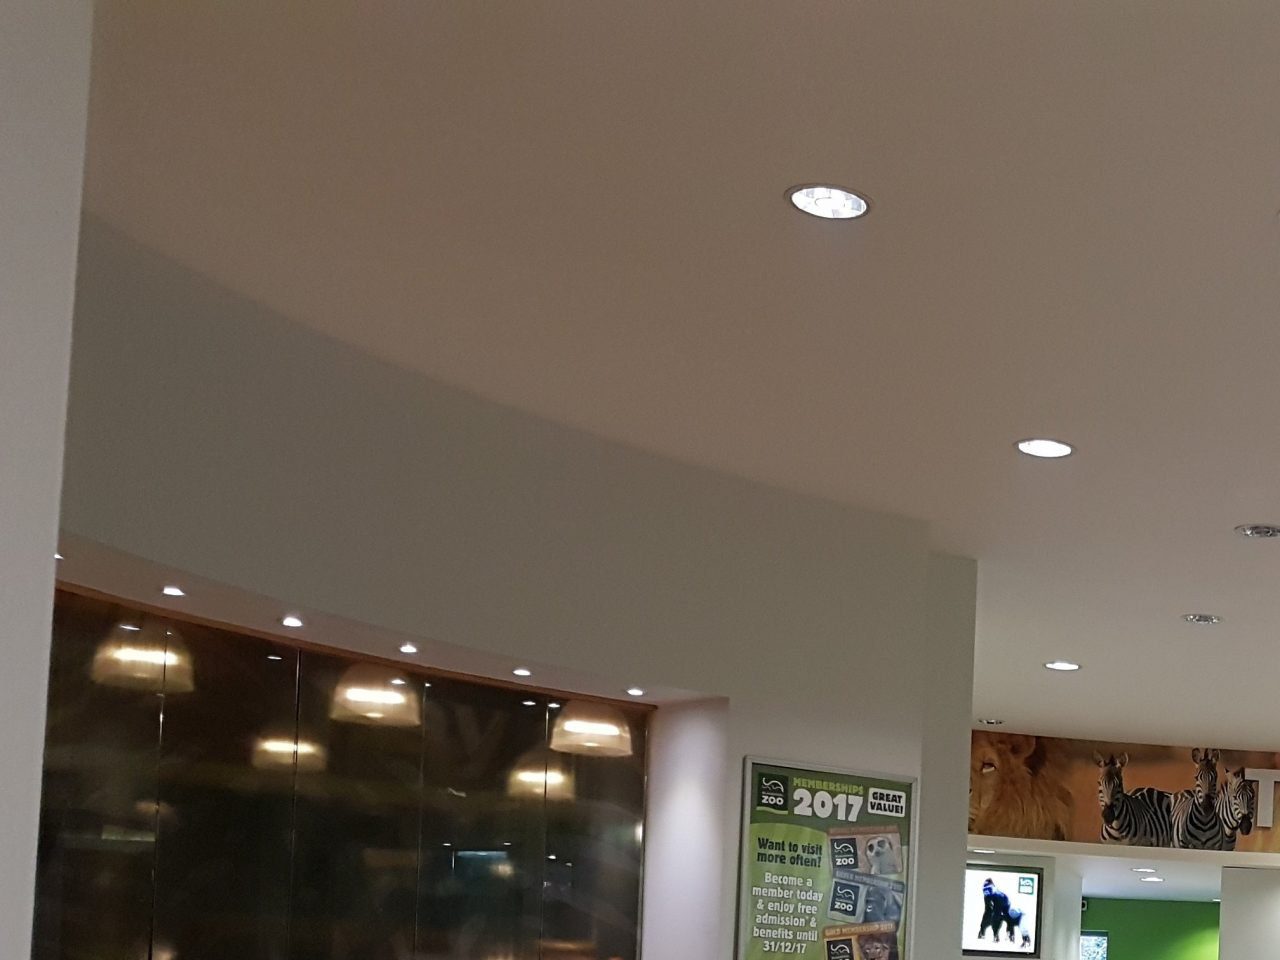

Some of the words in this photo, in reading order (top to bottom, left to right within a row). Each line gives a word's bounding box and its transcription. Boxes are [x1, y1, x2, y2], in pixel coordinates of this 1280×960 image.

[793, 777, 864, 795] MEMBERSHIPS
[761, 795, 784, 806] ZOO
[792, 788, 864, 822] 2017
[872, 791, 903, 804] GREAT
[870, 801, 904, 815] VALUE!
[757, 837, 785, 852] Want
[789, 841, 798, 853] to
[801, 843, 823, 856] visit
[757, 852, 786, 865] more
[789, 854, 822, 868] often?
[835, 857, 855, 866] ZOO
[764, 871, 803, 887] Become
[806, 877, 813, 887] a
[752, 886, 794, 898] member
[796, 888, 824, 902] today
[756, 899, 765, 910] &
[767, 900, 795, 914] enjoy
[797, 902, 818, 914] free
[834, 901, 854, 912] ZOO
[809, 916, 817, 928] &
[753, 926, 794, 939] benefits
[796, 930, 818, 942] until
[762, 940, 807, 954] 31/12/17
